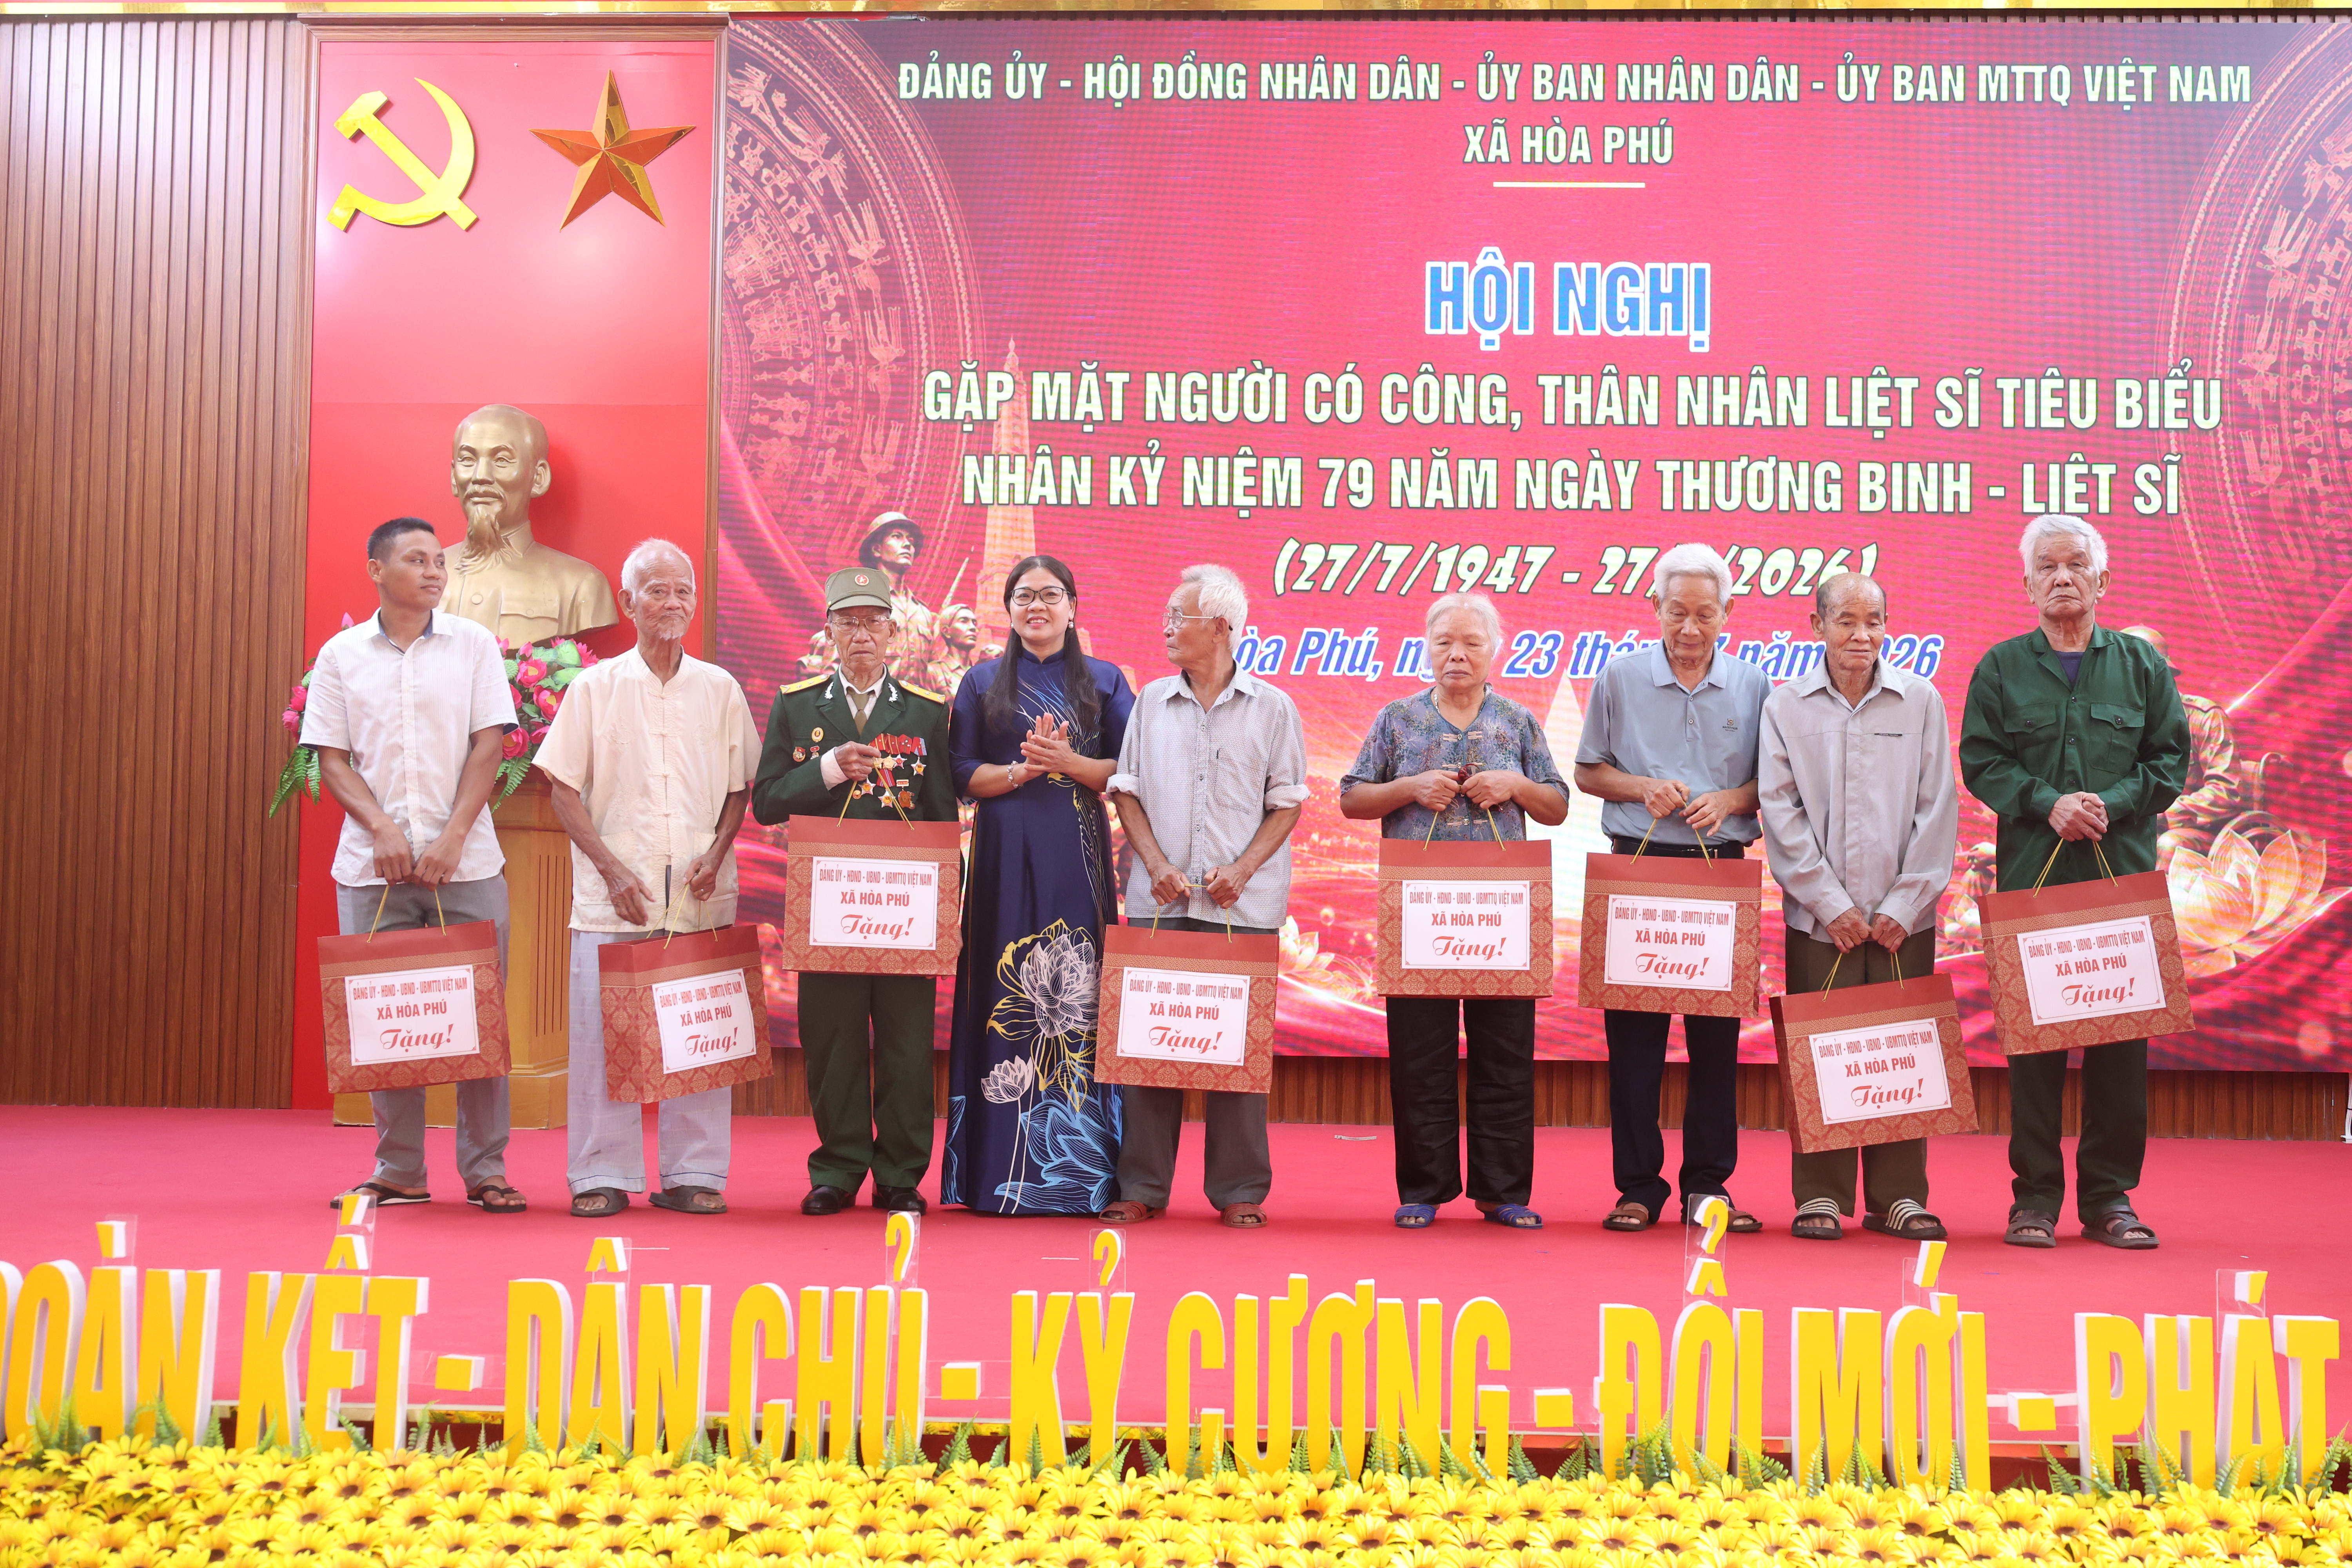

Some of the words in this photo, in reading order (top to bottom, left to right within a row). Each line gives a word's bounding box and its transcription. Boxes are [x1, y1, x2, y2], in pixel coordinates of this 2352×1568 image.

[897, 49, 992, 100] ĐẢNG
[1005, 49, 1048, 100] ỦY
[1059, 79, 1072, 88] -
[1084, 54, 1141, 108] HỘI
[1151, 49, 1247, 100] ĐỒNG
[1260, 54, 1356, 100] NHÂN
[1369, 55, 1440, 100] DÂN
[1452, 80, 1465, 89] -
[1477, 50, 1522, 101] ỦY
[1533, 63, 1604, 101] BAN
[1617, 55, 1714, 102] NHÂN
[1727, 56, 1799, 102] DÂN
[1811, 81, 1824, 90] -
[1837, 51, 1881, 102] ỦY
[1893, 64, 1965, 102] BAN
[1978, 64, 2071, 107] MTTQ
[2082, 56, 2158, 111] VIỆT
[2169, 64, 2251, 103] NAM
[1463, 118, 1510, 163] XÃ
[1522, 116, 1592, 163] HÒA
[1603, 118, 1673, 164] PHÚ
[1425, 247, 1534, 351] HỘI
[1553, 261, 1711, 352] NGHỊ
[923, 360, 1015, 433] GẶP
[1031, 361, 1130, 433] MẶT
[1145, 360, 1287, 423] NGƯỜI
[1304, 362, 1363, 424] CÓ
[1380, 363, 1522, 431] CÔNG,
[1537, 364, 1659, 425] THÂN
[1677, 365, 1808, 426] NHÂN
[1825, 366, 1919, 439] LIỆT
[1934, 367, 1983, 428] SĨ
[1996, 367, 2097, 429] TIÊU
[2115, 358, 2223, 430] BIỂU
[963, 445, 1092, 506] NHÂN
[1109, 438, 1166, 506] KỶ
[1182, 446, 1302, 518] NIỆM
[1318, 457, 1374, 508] 79
[1390, 447, 1498, 509] NĂM
[1515, 448, 1640, 510] NGÀY
[1655, 455, 1842, 512] THƯƠNG
[1858, 461, 1971, 513] BINH
[1988, 486, 2005, 497] -
[2133, 453, 2182, 515] SĨ
[1274, 537, 1555, 596] (27/7/1947
[1561, 571, 1581, 584] -
[1232, 626, 1287, 675] òa
[1290, 628, 1384, 682] Phú,
[1502, 630, 1564, 678] 23
[1736, 631, 1827, 680] năm
[820, 864, 834, 881] ĐẢNG
[835, 864, 842, 882] ỦY
[847, 870, 861, 882] HĐND
[866, 871, 880, 883] UBND
[886, 872, 906, 886] UBMTTQ
[908, 871, 918, 887] VIỆT
[920, 873, 932, 886] NAM
[840, 889, 856, 904] XÃ
[860, 890, 882, 905] HÒA
[887, 892, 909, 907] PHÚ
[1410, 887, 1424, 904] ĐẢNG
[1426, 887, 1432, 904] ỦY
[1437, 892, 1451, 904] HĐND
[1457, 892, 1471, 904] UBND
[1476, 893, 1497, 906] UBMTTQ
[1499, 890, 1510, 907] VIỆT
[1511, 893, 1523, 904] NAM
[841, 914, 914, 940] Tặng!
[1431, 911, 1446, 926] XÃ
[1451, 911, 1474, 926] HÒA
[1478, 911, 1501, 927] PHÚ
[1615, 902, 1629, 920] ĐẢNG
[1631, 902, 1638, 920] ỦY
[1642, 908, 1657, 921] HĐND
[1662, 909, 1676, 922] UBND
[1681, 911, 1702, 925] UBMTTQ
[1704, 910, 1715, 927] VIỆT
[1716, 913, 1729, 926] NAM
[1432, 936, 1506, 961] Tặng!
[1635, 928, 1651, 943] XÃ
[1655, 929, 1677, 944] HÒA
[1682, 931, 1705, 946] PHÚ
[2028, 940, 2045, 958] ĐẢNG
[2045, 938, 2052, 956] ỦY
[2056, 940, 2073, 954] HĐND
[2076, 938, 2092, 951] UBND
[2096, 934, 2119, 949] UBMTTQ
[2118, 930, 2131, 947] VIỆT
[2131, 930, 2145, 944] NAM
[1635, 953, 1710, 980] Tặng!
[2055, 960, 2073, 976] XÃ
[2075, 957, 2100, 974] HÒA
[2102, 953, 2127, 970] PHÚ
[1130, 974, 1144, 992] ĐẢNG
[1145, 975, 1152, 993] ỦY
[1157, 981, 1172, 994] HĐND
[1176, 983, 1191, 996] UBND
[1196, 984, 1217, 999] UBMTTQ
[1218, 984, 1229, 1001] VIỆT
[1230, 987, 1243, 1000] NAM
[2062, 977, 2134, 1007] Tặng!
[377, 1004, 393, 1020] XÃ
[396, 1002, 420, 1018] HÒA
[423, 999, 447, 1015] PHÚ
[680, 1011, 693, 1027] XÃ
[695, 1007, 713, 1024] HÒA
[715, 1003, 732, 1020] PHÚ
[1149, 1001, 1165, 1016] XÃ
[1169, 1002, 1191, 1018] HÒA
[1196, 1005, 1219, 1020] PHÚ
[380, 1024, 454, 1053] Tặng!
[685, 1027, 738, 1058] Tặng!
[1149, 1026, 1223, 1054] Tặng!
[1818, 1040, 1835, 1058] ĐẢNG
[1834, 1038, 1842, 1056] ỦY
[1846, 1040, 1862, 1054] HĐND
[1866, 1038, 1881, 1051] UBND
[1885, 1034, 1907, 1049] UBMTTQ
[1907, 1030, 1919, 1048] VIỆT
[1919, 1031, 1933, 1044] NAM
[1845, 1061, 1862, 1077] XÃ
[1864, 1058, 1889, 1074] HÒA
[1891, 1053, 1915, 1071] PHÚ
[1851, 1078, 1924, 1109] Tặng!
[0, 1220, 220, 1446] OÀN
[236, 1194, 429, 1451] KẾT
[435, 1354, 485, 1391] -
[505, 1237, 711, 1460] DÂN
[729, 1211, 927, 1464] CHỦ
[941, 1362, 981, 1400] -
[1011, 1229, 1135, 1465] KỶ
[1166, 1273, 1511, 1477] CƯƠNG
[1534, 1388, 1573, 1428] -
[1593, 1196, 1763, 1479] ĐỔI
[1791, 1241, 1991, 1490] MỚI
[2008, 1392, 2056, 1431] -
[2074, 1270, 2339, 1490] PHÁT
